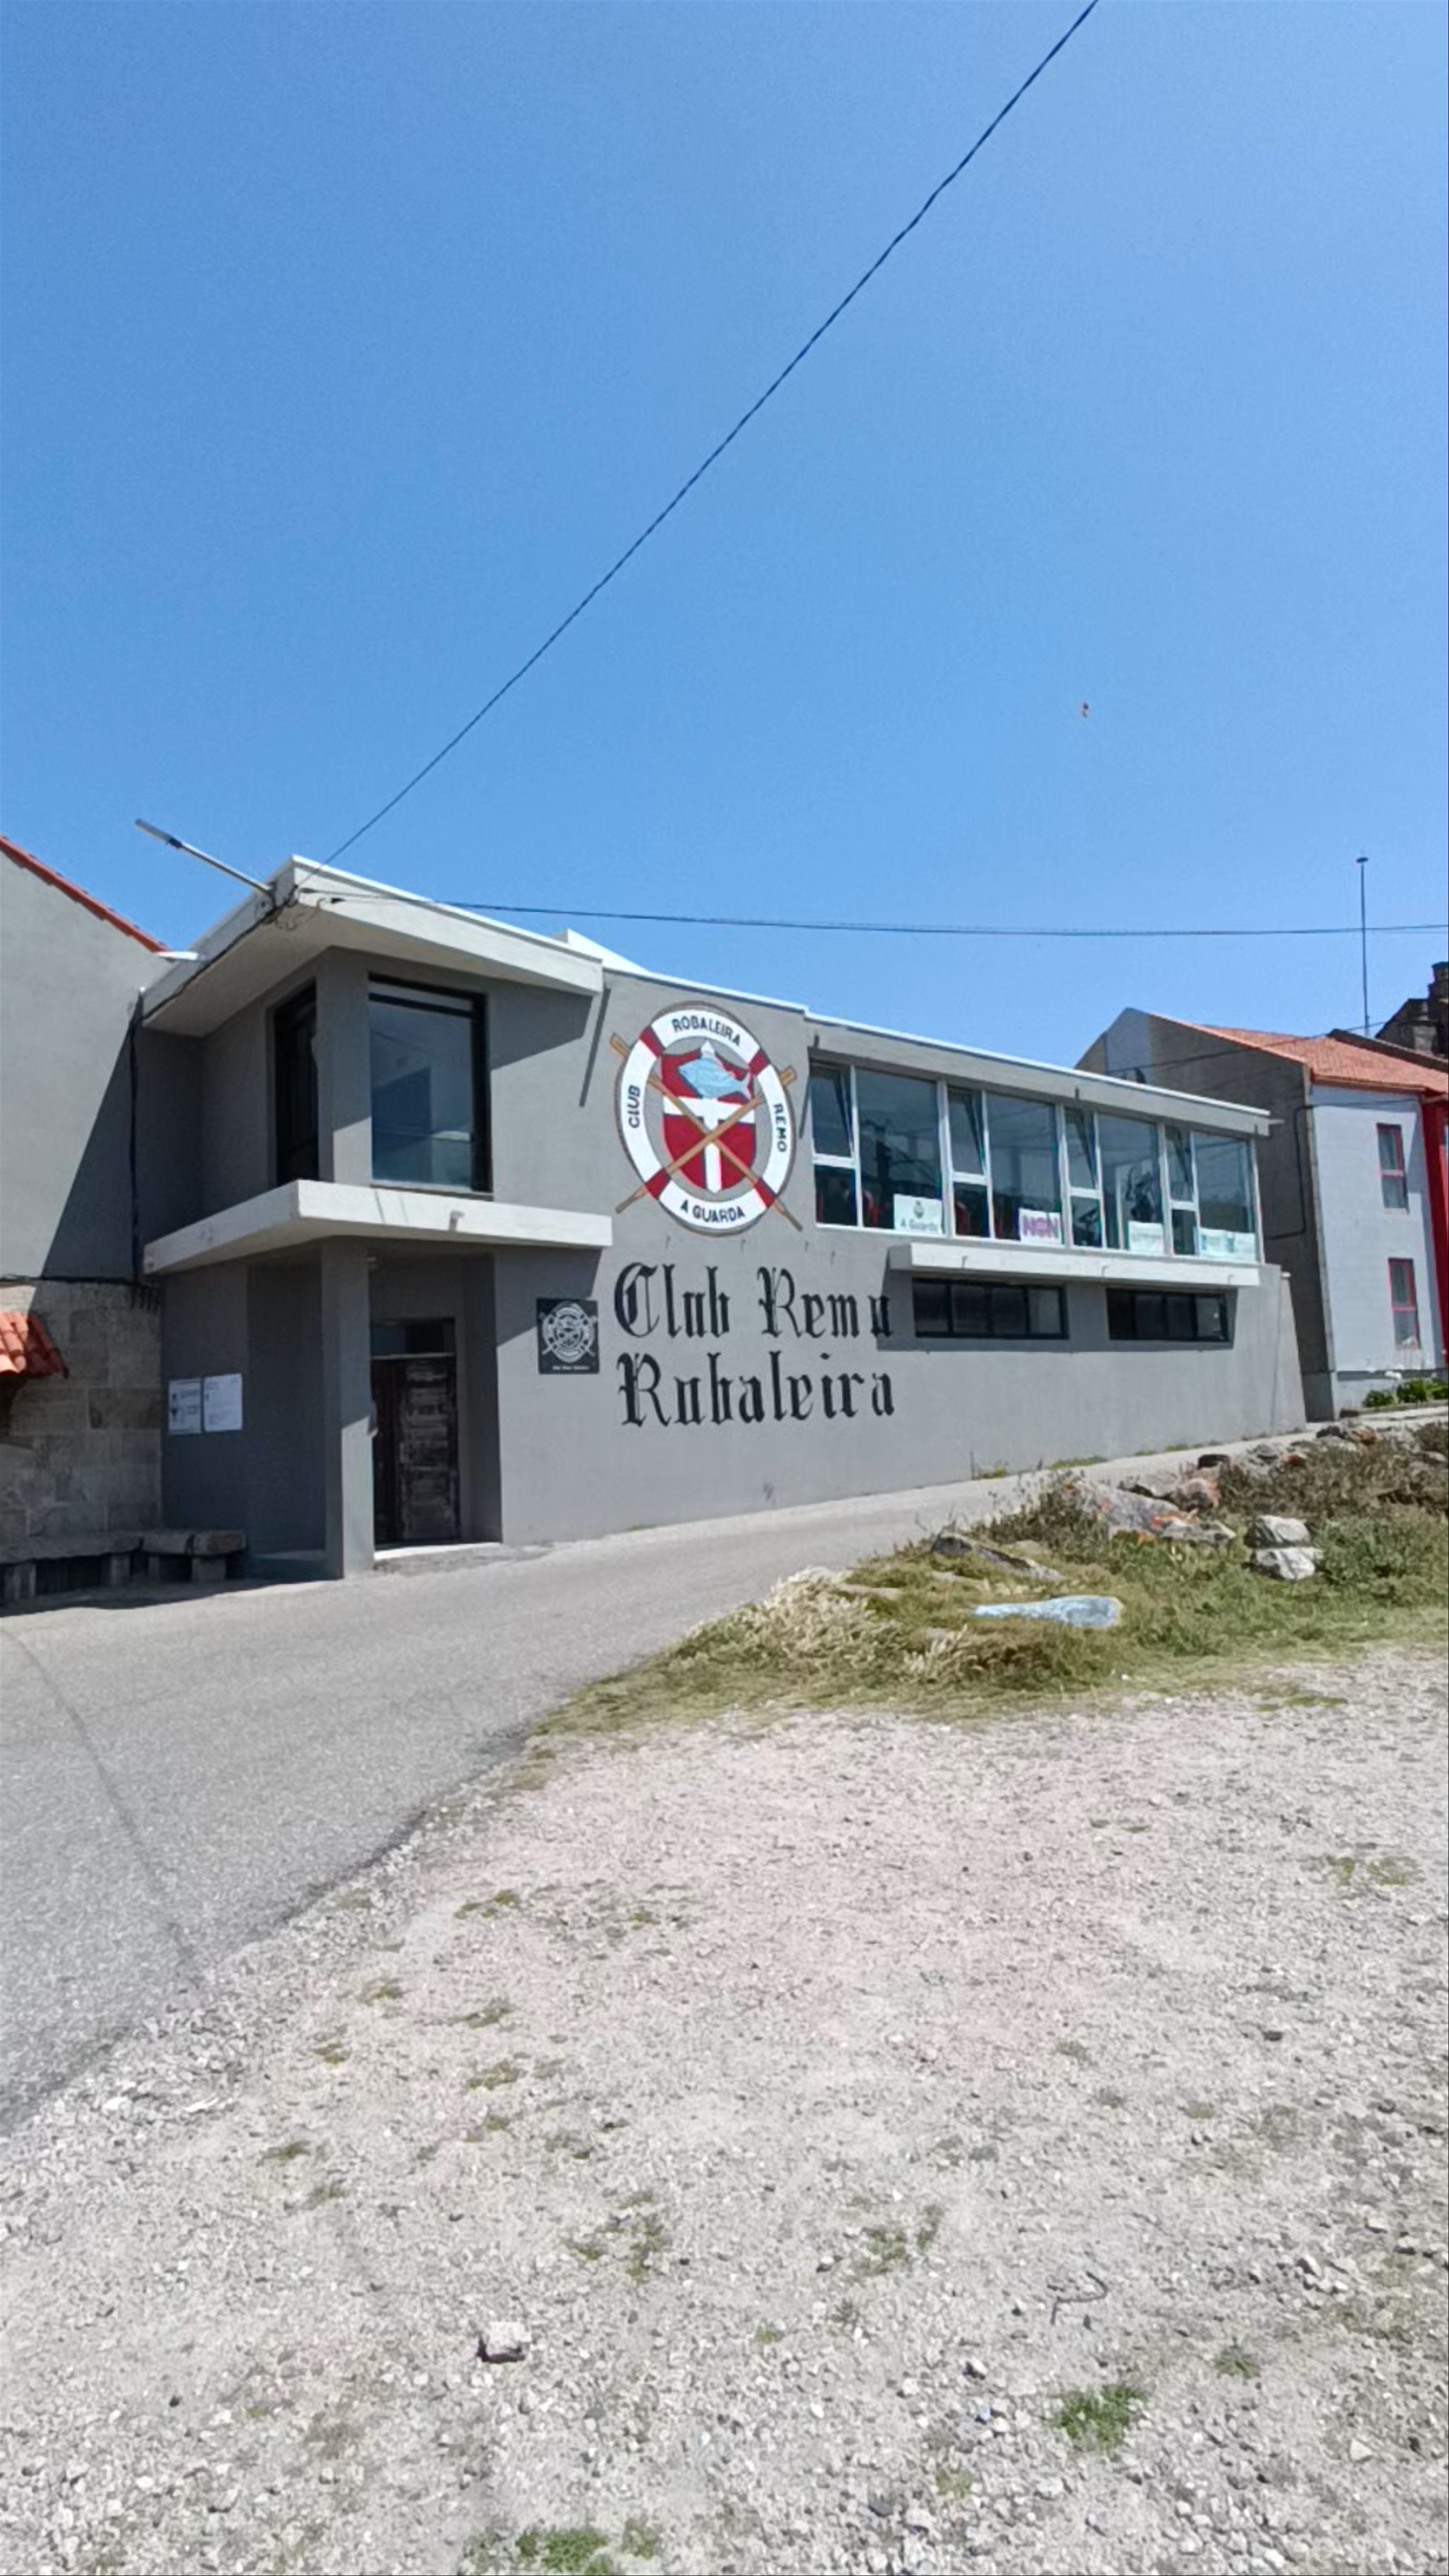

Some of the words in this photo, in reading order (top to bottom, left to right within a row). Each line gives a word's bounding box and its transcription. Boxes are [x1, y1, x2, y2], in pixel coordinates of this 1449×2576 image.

[671, 1016, 741, 1047] ROBALEIRA
[628, 1085, 641, 1128] CLUB
[774, 1103, 786, 1152] REMO
[681, 1200, 689, 1212] A
[692, 1206, 746, 1222] GUARDA
[614, 1262, 731, 1338] Club
[616, 1350, 895, 1427] Robaleira
